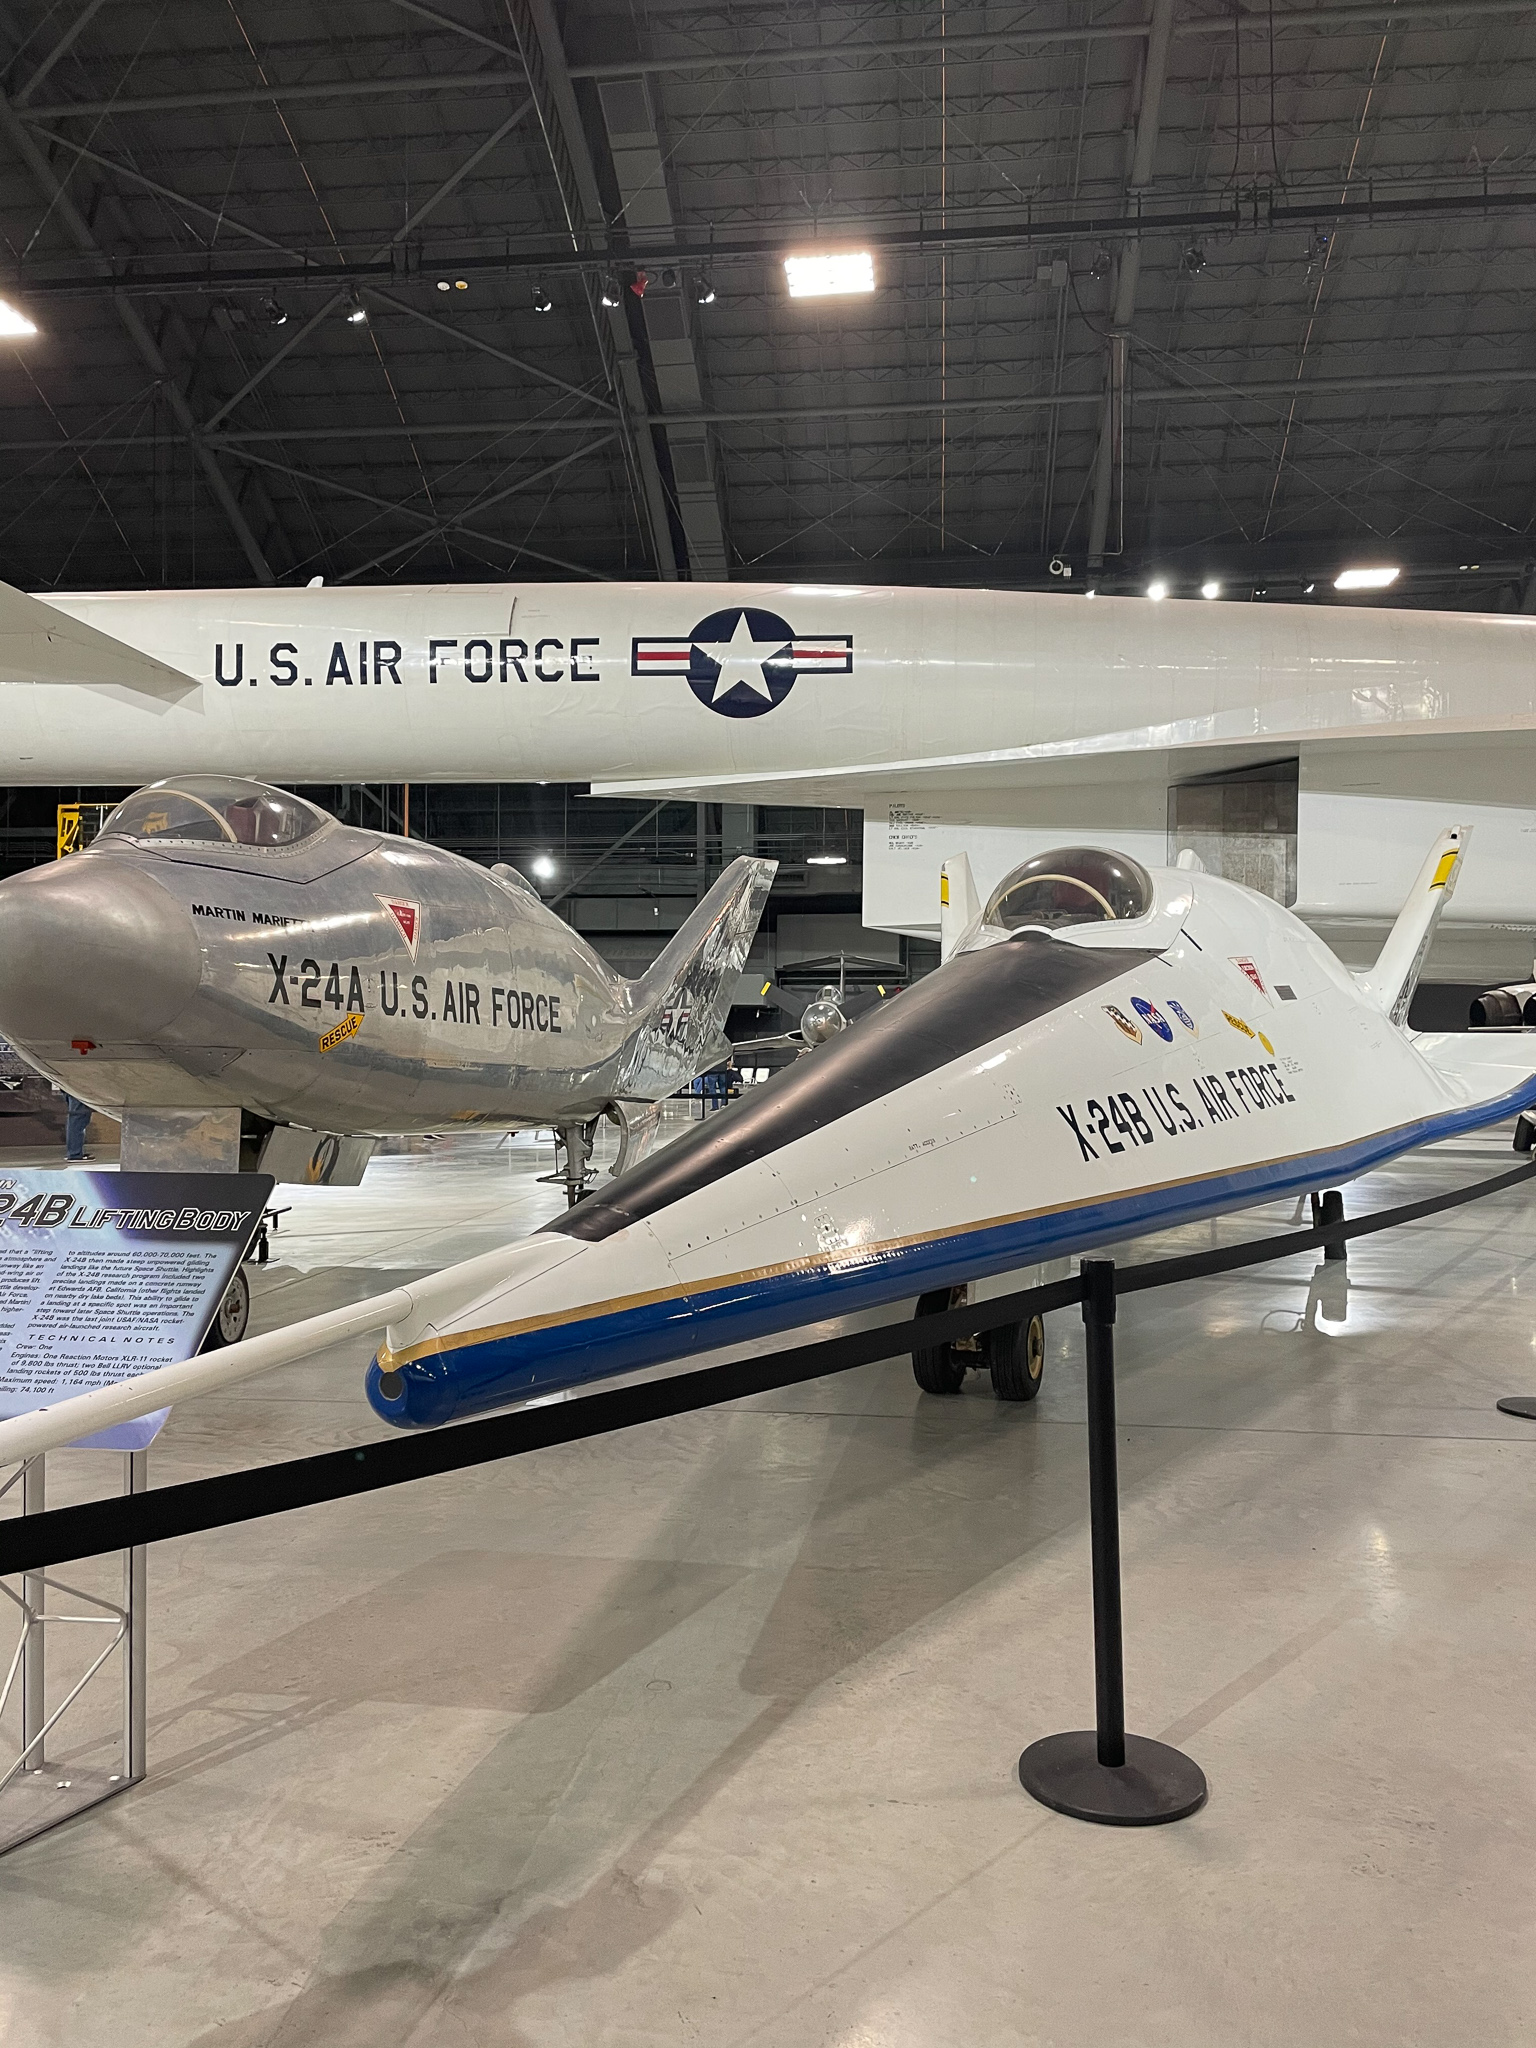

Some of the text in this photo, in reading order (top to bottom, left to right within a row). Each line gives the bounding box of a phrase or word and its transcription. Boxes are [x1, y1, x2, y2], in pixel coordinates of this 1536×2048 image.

[216, 638, 600, 687] U.S. AIR FORCE
[191, 903, 246, 922] MARTIN
[267, 953, 562, 1034] X-24A U.S. AIR FORCE
[322, 1016, 357, 1050] RESCUE
[1141, 1012, 1165, 1024] NASA
[1056, 1063, 1296, 1163] X-24B U.S. AIR FORCE
[0, 1193, 251, 1231] 24B LIFTING BODY
